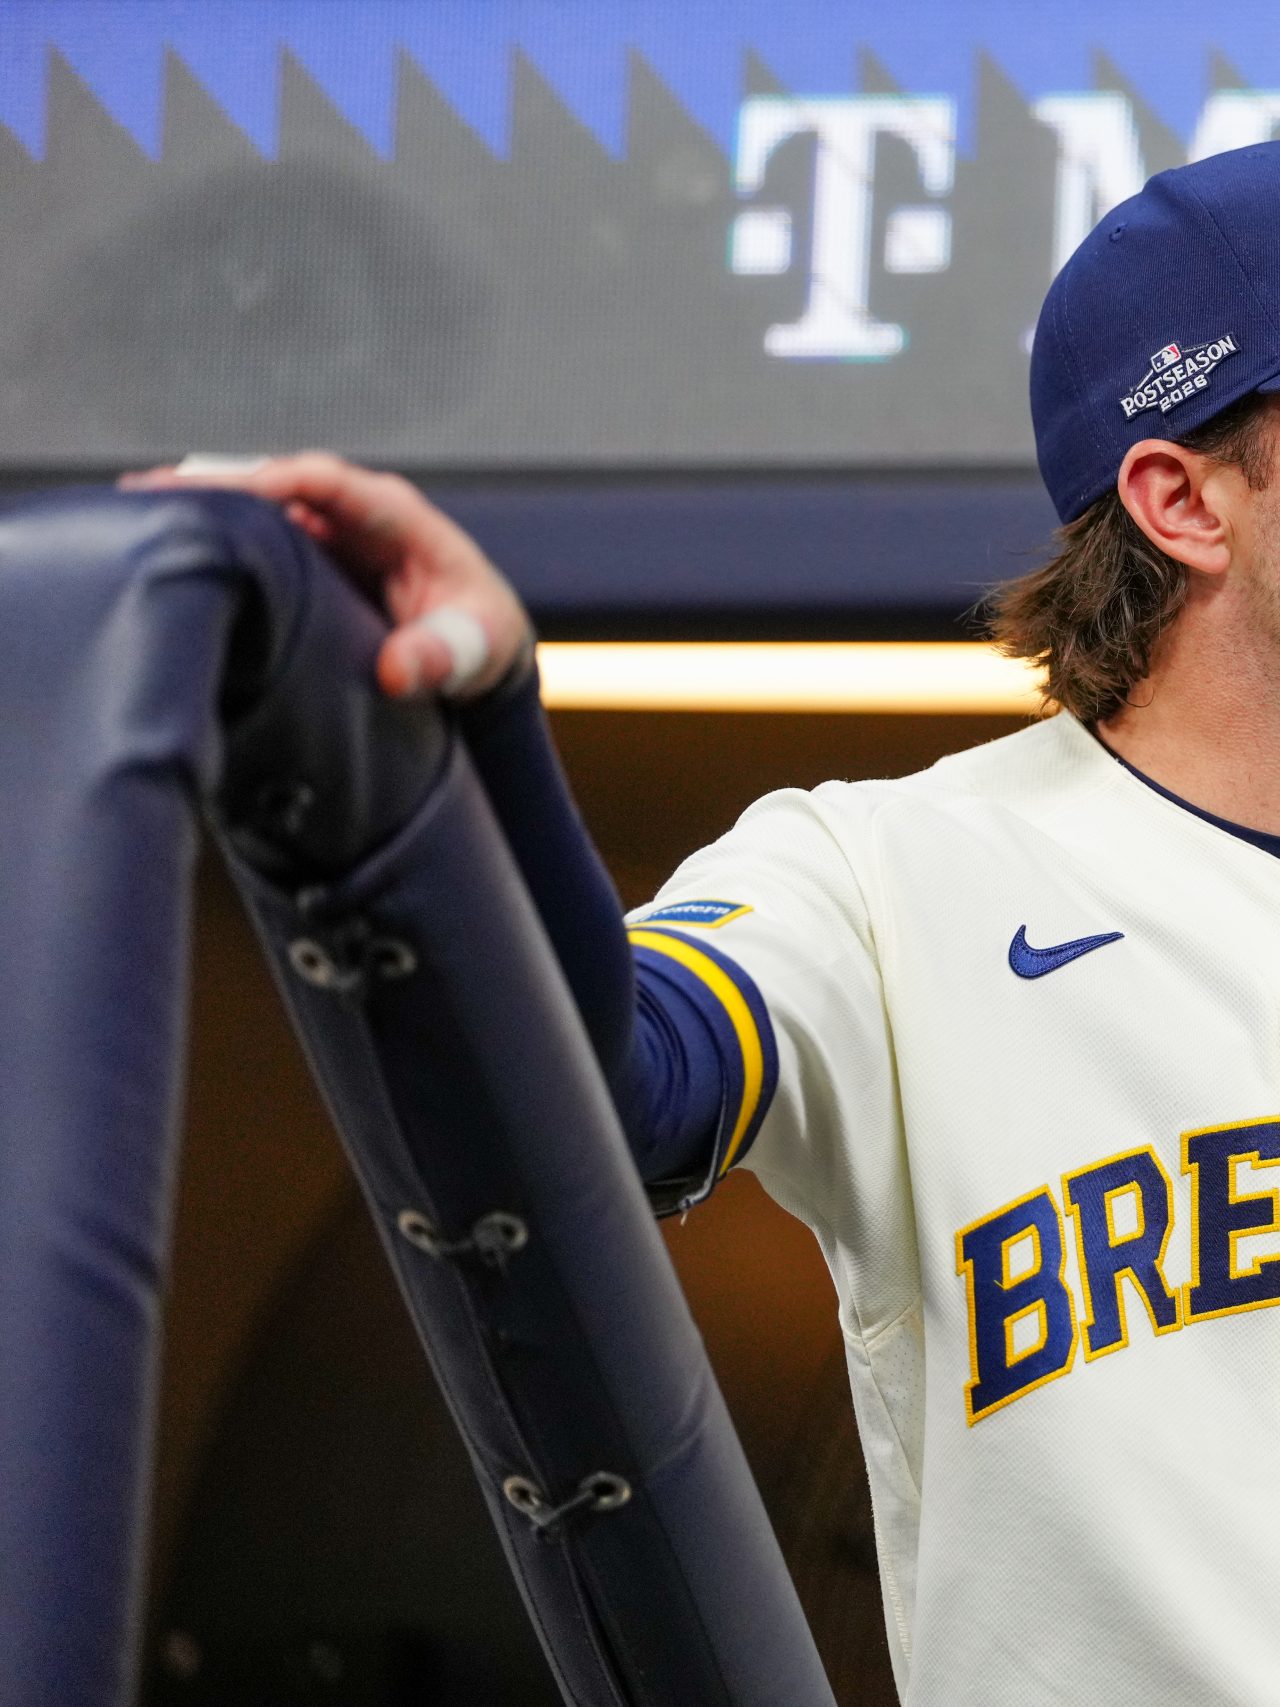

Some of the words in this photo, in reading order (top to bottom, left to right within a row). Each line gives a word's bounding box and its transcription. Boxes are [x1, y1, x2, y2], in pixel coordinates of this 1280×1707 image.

[732, 94, 956, 358] T
[1120, 335, 1236, 418] POSTSEASON
[1159, 374, 1208, 412] 2026
